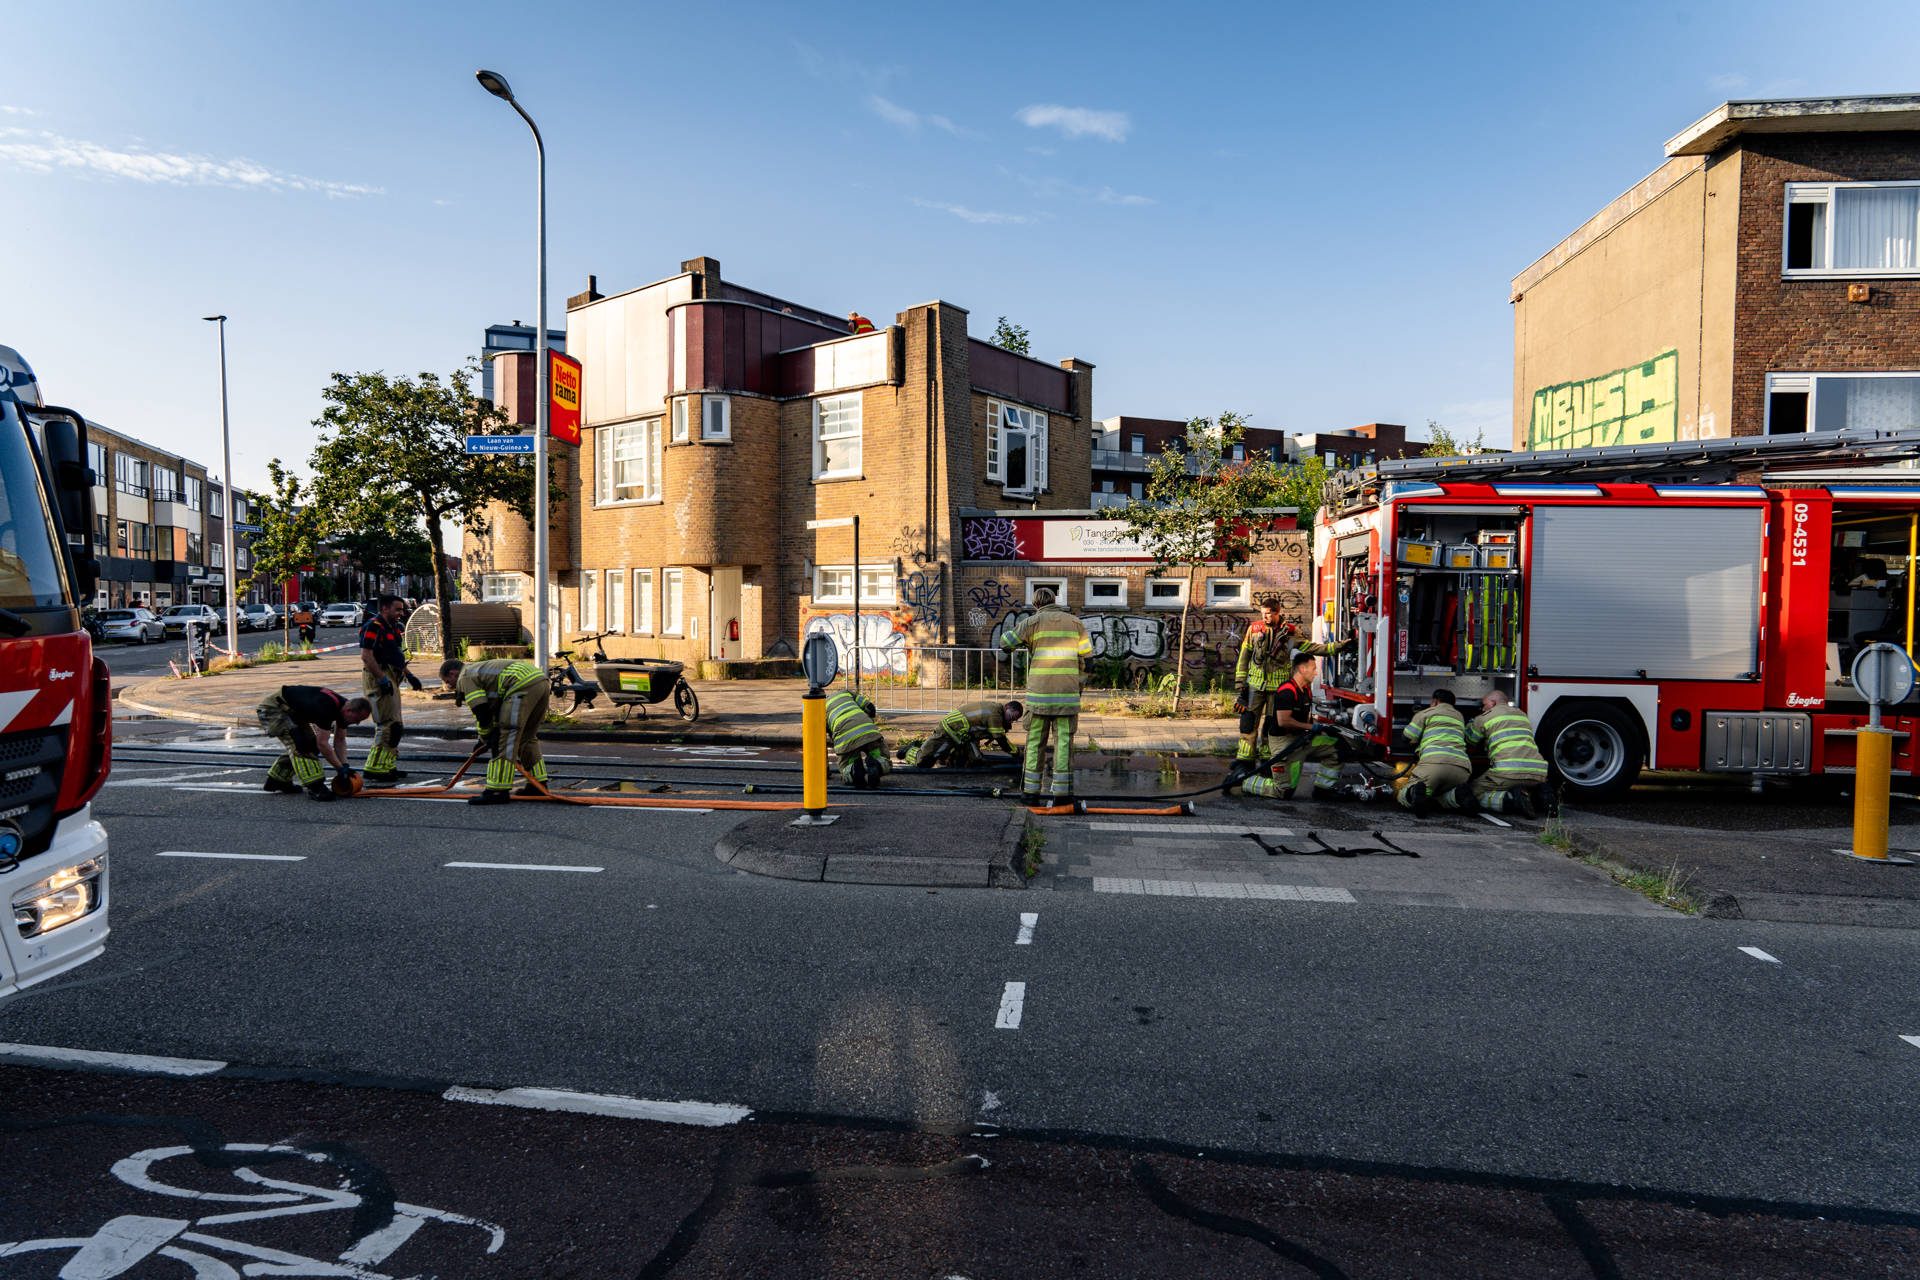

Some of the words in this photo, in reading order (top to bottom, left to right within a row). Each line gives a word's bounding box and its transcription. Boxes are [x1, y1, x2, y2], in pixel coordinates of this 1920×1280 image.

[555, 364, 577, 389] Netto
[555, 383, 577, 404] rama
[1792, 503, 1809, 566] 09-4531
[1786, 692, 1825, 707] Ziegler
